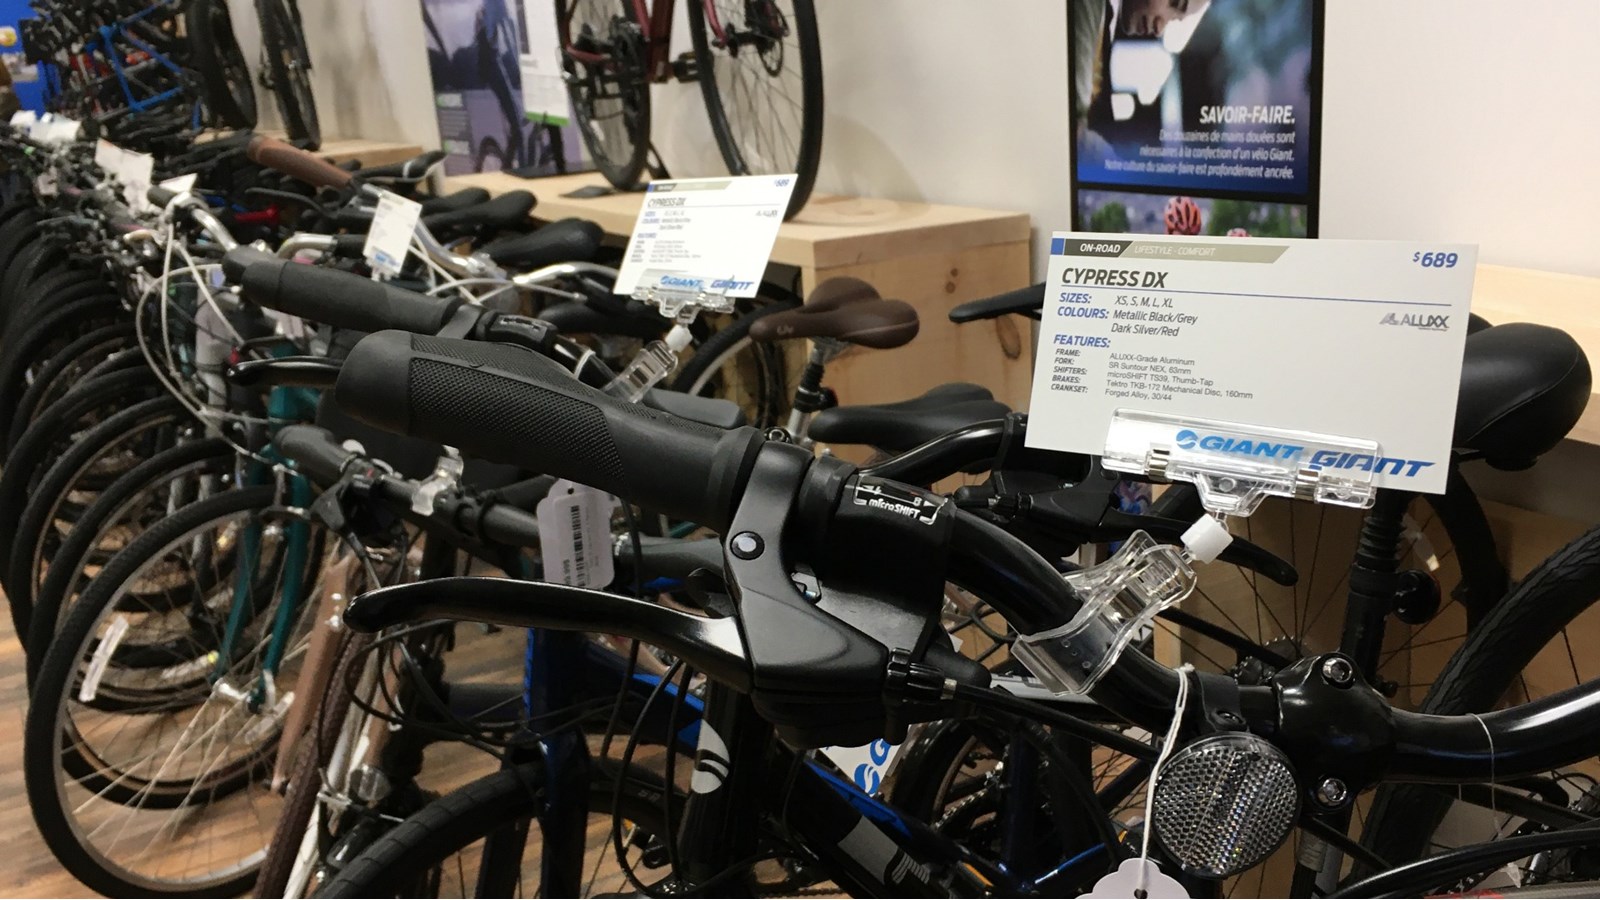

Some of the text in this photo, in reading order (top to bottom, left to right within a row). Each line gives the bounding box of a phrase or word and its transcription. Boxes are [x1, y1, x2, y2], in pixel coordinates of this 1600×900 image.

[1200, 105, 1295, 124] SAVOIR-FAIRE.
[1276, 131, 1295, 144] sont
[1270, 148, 1295, 162] Giant.
[1195, 163, 1208, 175] est
[1208, 163, 1264, 178] profondément
[1264, 165, 1295, 179] ancrée.
[1080, 243, 1121, 254] ON-ROAD
[1134, 245, 1172, 255] LIFESTYLE
[1178, 247, 1216, 257] COMFORT
[1412, 251, 1459, 268] $689
[1062, 267, 1168, 288] CYPRESS DX
[1059, 292, 1174, 308] SIZES: XS, S, M, L, XL
[1057, 306, 1198, 325] COLOURS: Metallic Black/Grey
[1400, 313, 1449, 329] ALUXX
[1111, 323, 1179, 336] Dark Silver/Red
[1053, 334, 1111, 348] FEATURES:
[1054, 357, 1075, 365] FORK:
[1120, 363, 1148, 371] Suntour
[1150, 365, 1167, 373] NEX,
[1168, 367, 1192, 375] 63mm
[1055, 348, 1195, 366] FRAME: ALUXX-Grade Aluminum
[1053, 366, 1087, 375] SHIFTERS:
[1107, 371, 1148, 381] microSHIFT
[1172, 375, 1214, 387] Thumb-Tap
[1050, 383, 1172, 401] CRANKSET: Forged Alloy, 30/44
[1052, 375, 1253, 399] BRAKES: Tektro TKB-172 Mechanical Disc, 160mm
[1200, 435, 1304, 459] GIANT
[1309, 450, 1436, 478] GIANT
[868, 498, 921, 519] microSHIFT
